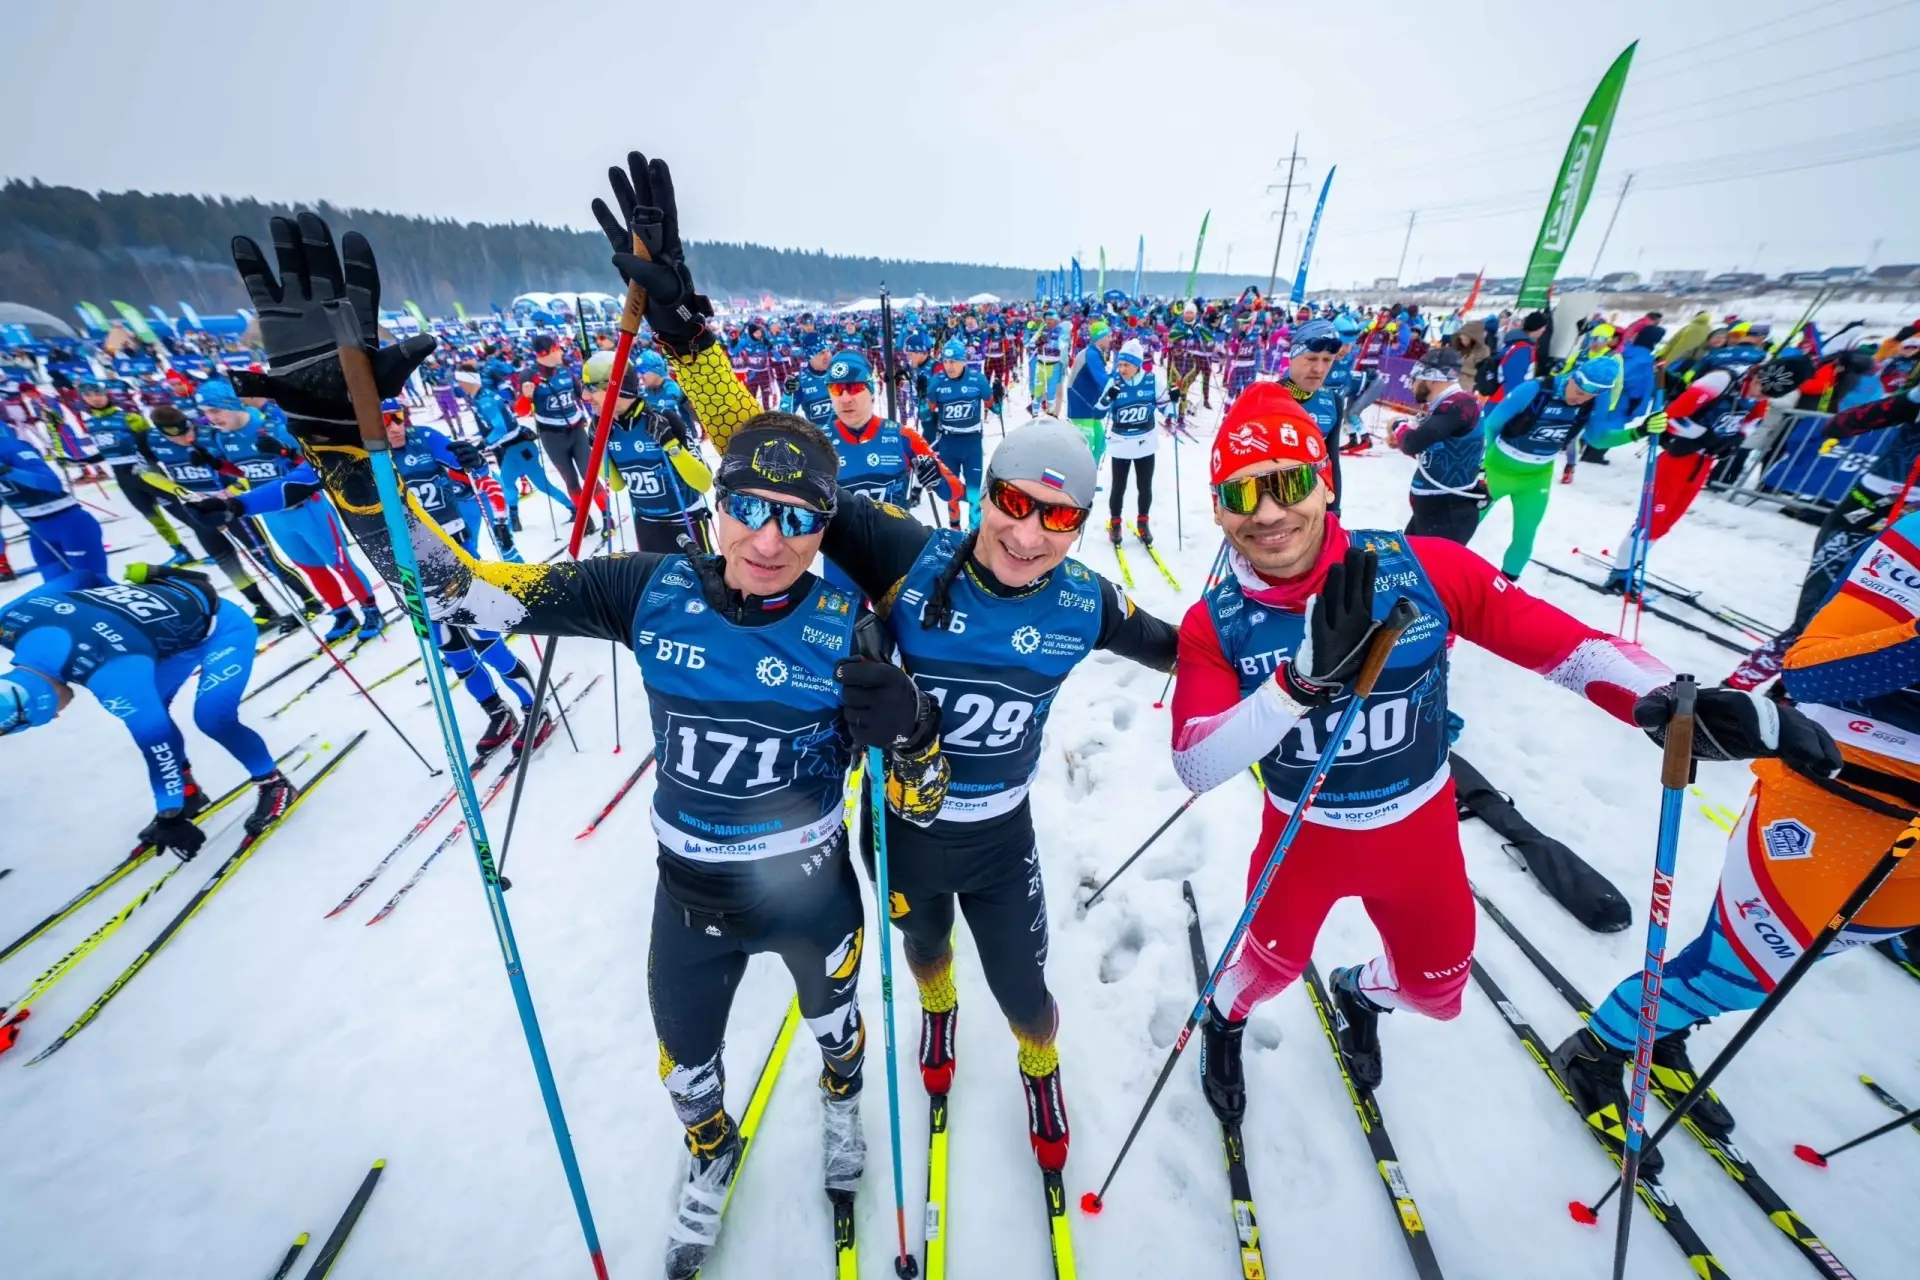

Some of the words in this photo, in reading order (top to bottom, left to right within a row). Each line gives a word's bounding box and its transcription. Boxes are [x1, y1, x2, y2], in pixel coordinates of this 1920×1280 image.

[945, 404, 972, 419] 287
[1119, 406, 1148, 423] 220
[1374, 571, 1417, 586] RUSSIA
[803, 625, 844, 644] RUSSIA
[1405, 618, 1441, 635] ЫЖНЫЙ
[1393, 631, 1431, 647] АРАФОН
[656, 639, 706, 670] ВТБ
[921, 686, 1034, 748] 129
[1295, 698, 1408, 761] 130
[676, 726, 781, 788] 171
[151, 742, 182, 796] FRANCE
[1344, 802, 1399, 819] ЮГОРИЯ
[705, 842, 766, 853] ЮГОРИЯ
[1650, 867, 1675, 927] KV+
